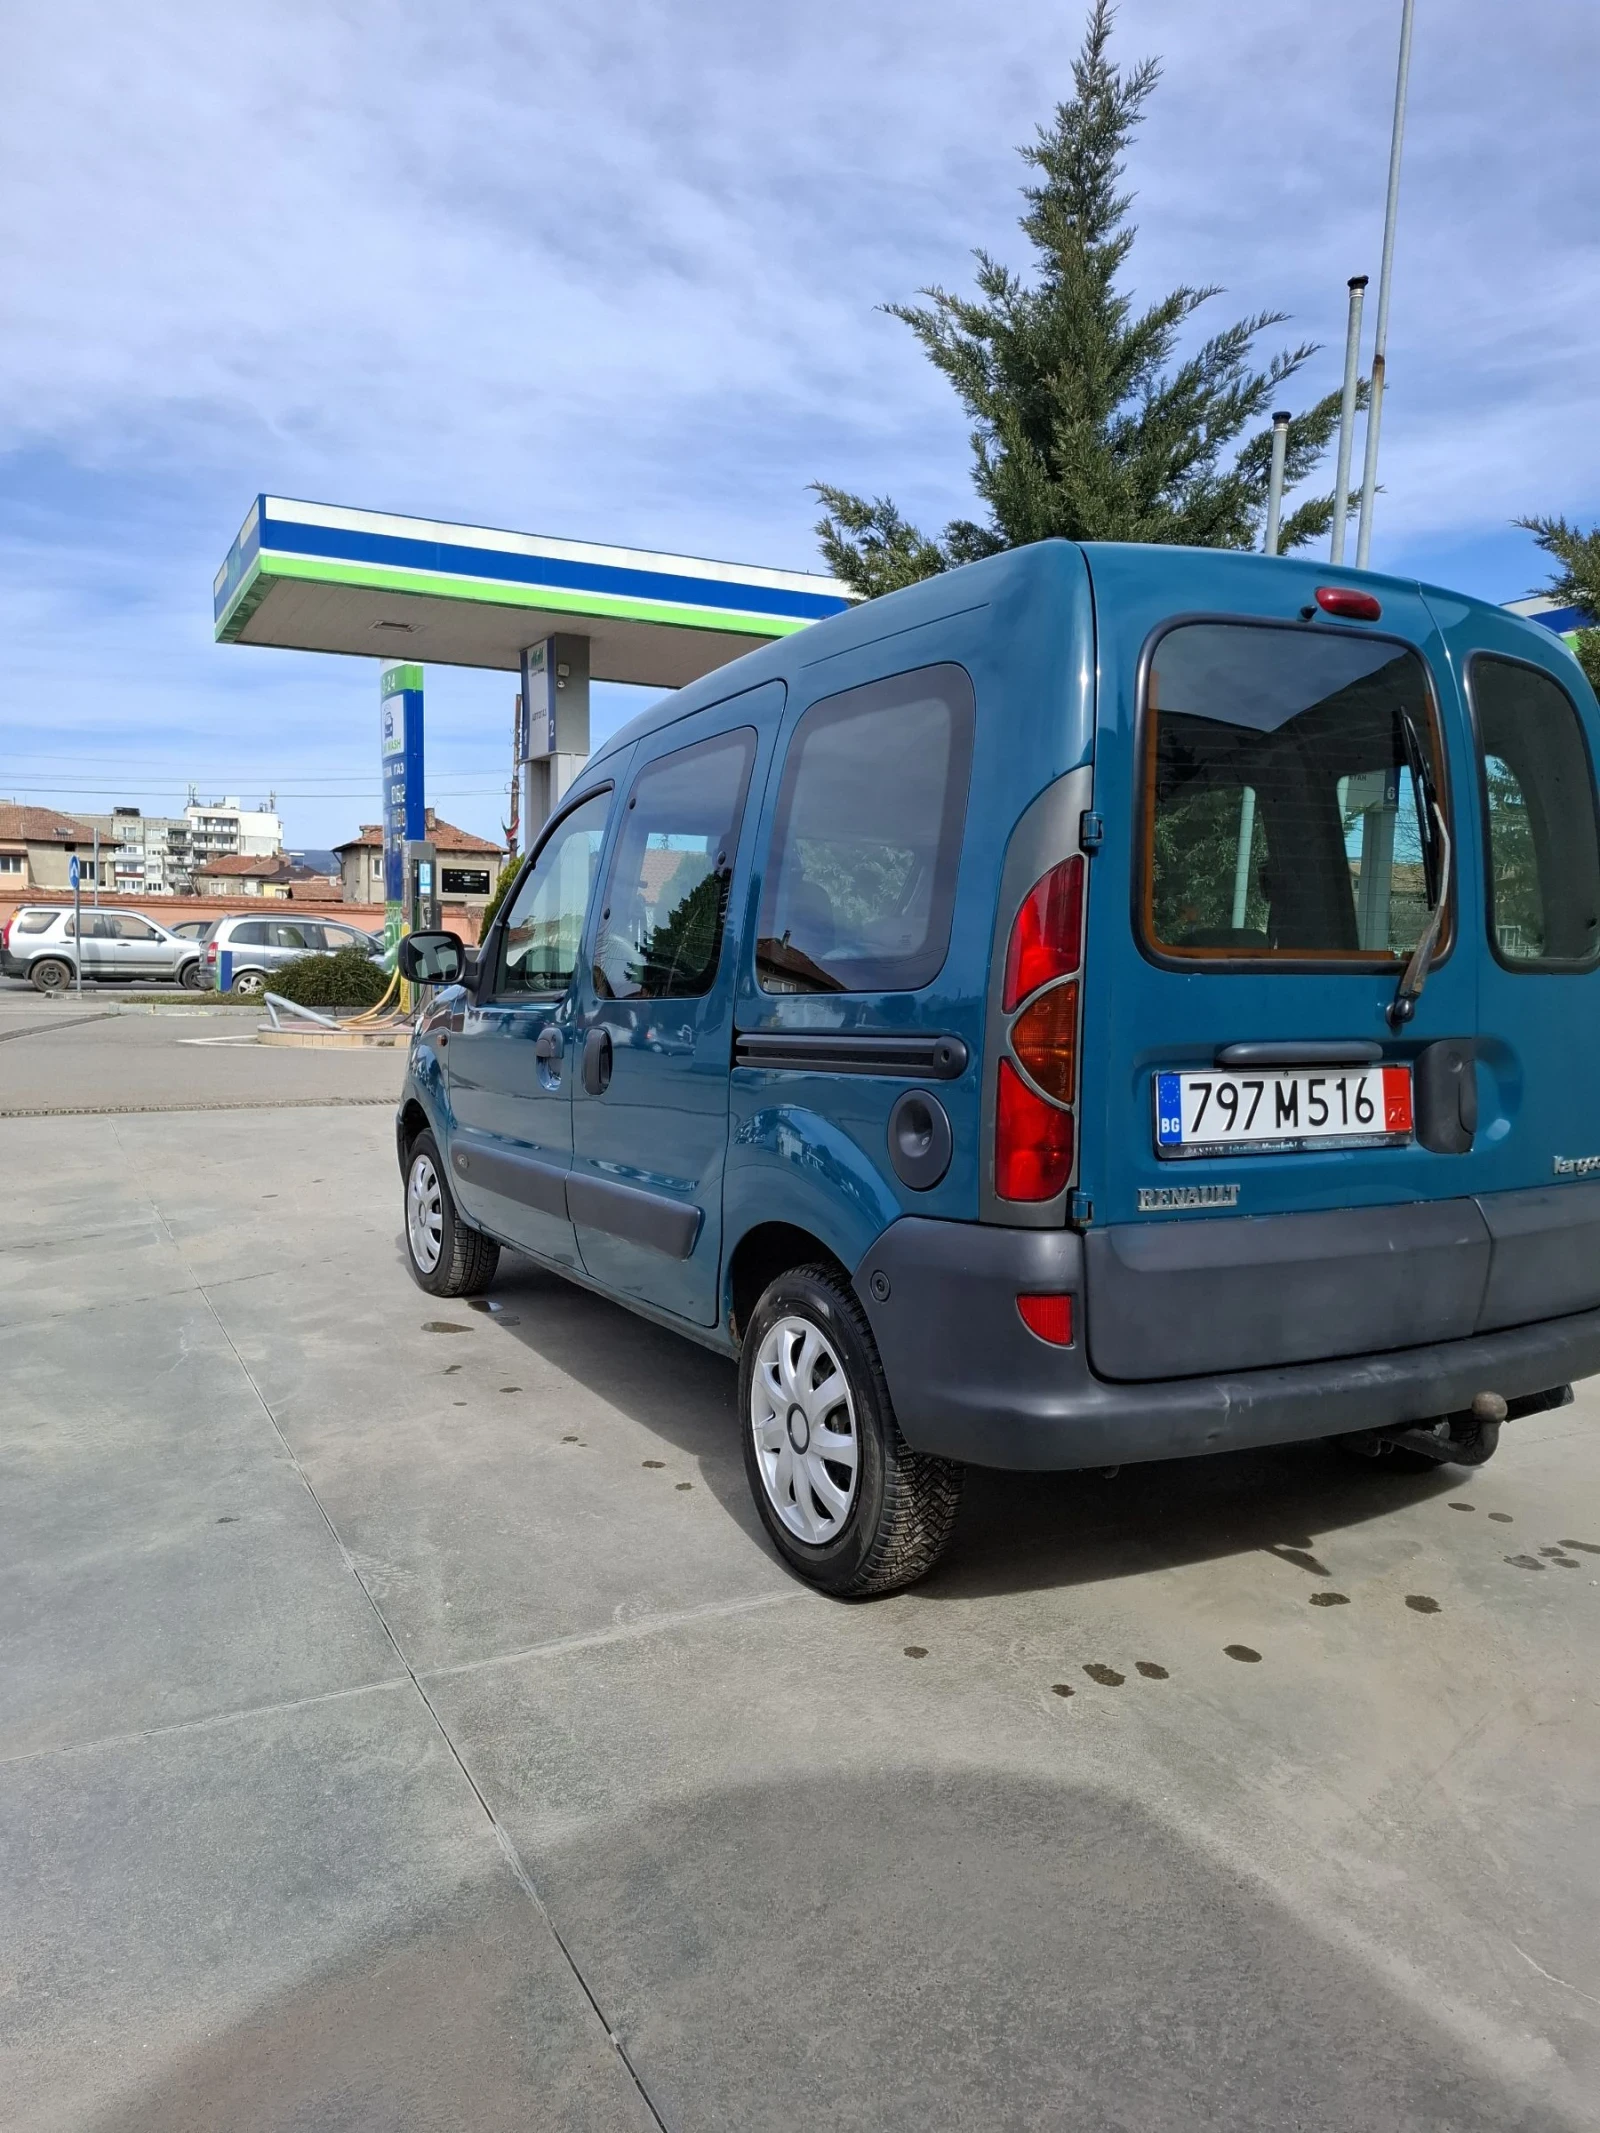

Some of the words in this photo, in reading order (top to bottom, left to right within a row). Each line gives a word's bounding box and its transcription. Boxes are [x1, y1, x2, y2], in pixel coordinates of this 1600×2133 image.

[549, 719, 554, 737] 2
[1386, 786, 1396, 800] 6
[1161, 1117, 1180, 1134] BG
[1137, 1184, 1241, 1212] RENAULT
